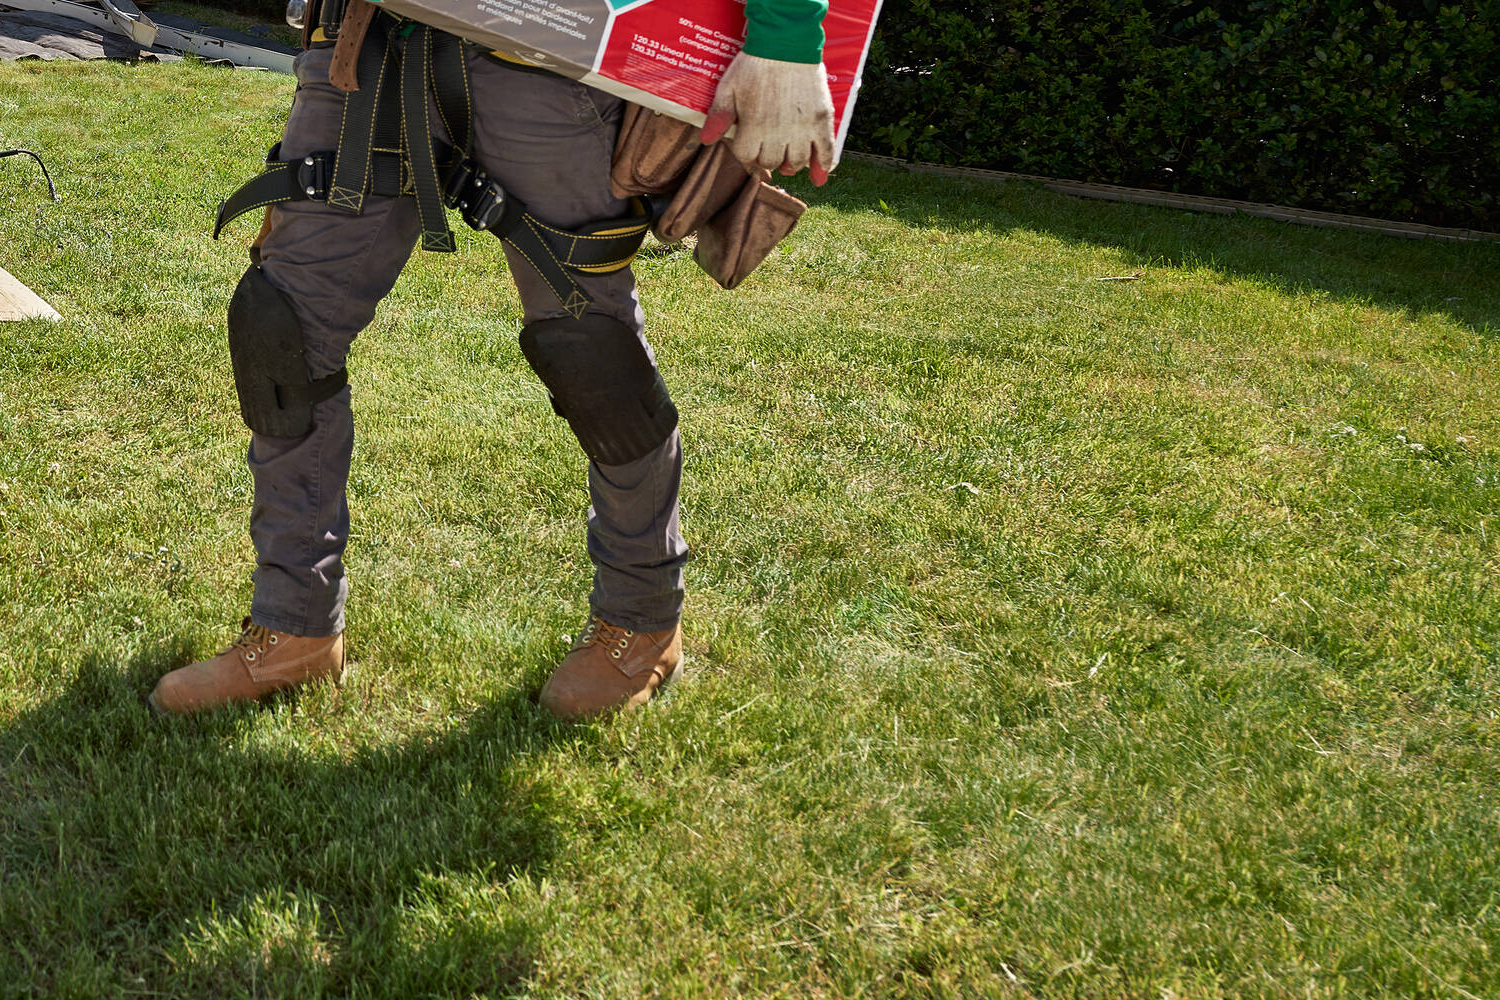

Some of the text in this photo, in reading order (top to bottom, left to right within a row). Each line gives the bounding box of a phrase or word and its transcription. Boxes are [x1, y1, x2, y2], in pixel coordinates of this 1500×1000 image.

[522, 3, 541, 13] pour
[679, 17, 693, 28] 50%
[694, 24, 713, 35] more
[631, 42, 656, 57] 120.33
[656, 53, 678, 66] pieds
[634, 34, 717, 68] 120.33 Lineal Feet Per
[720, 43, 730, 51] 50
